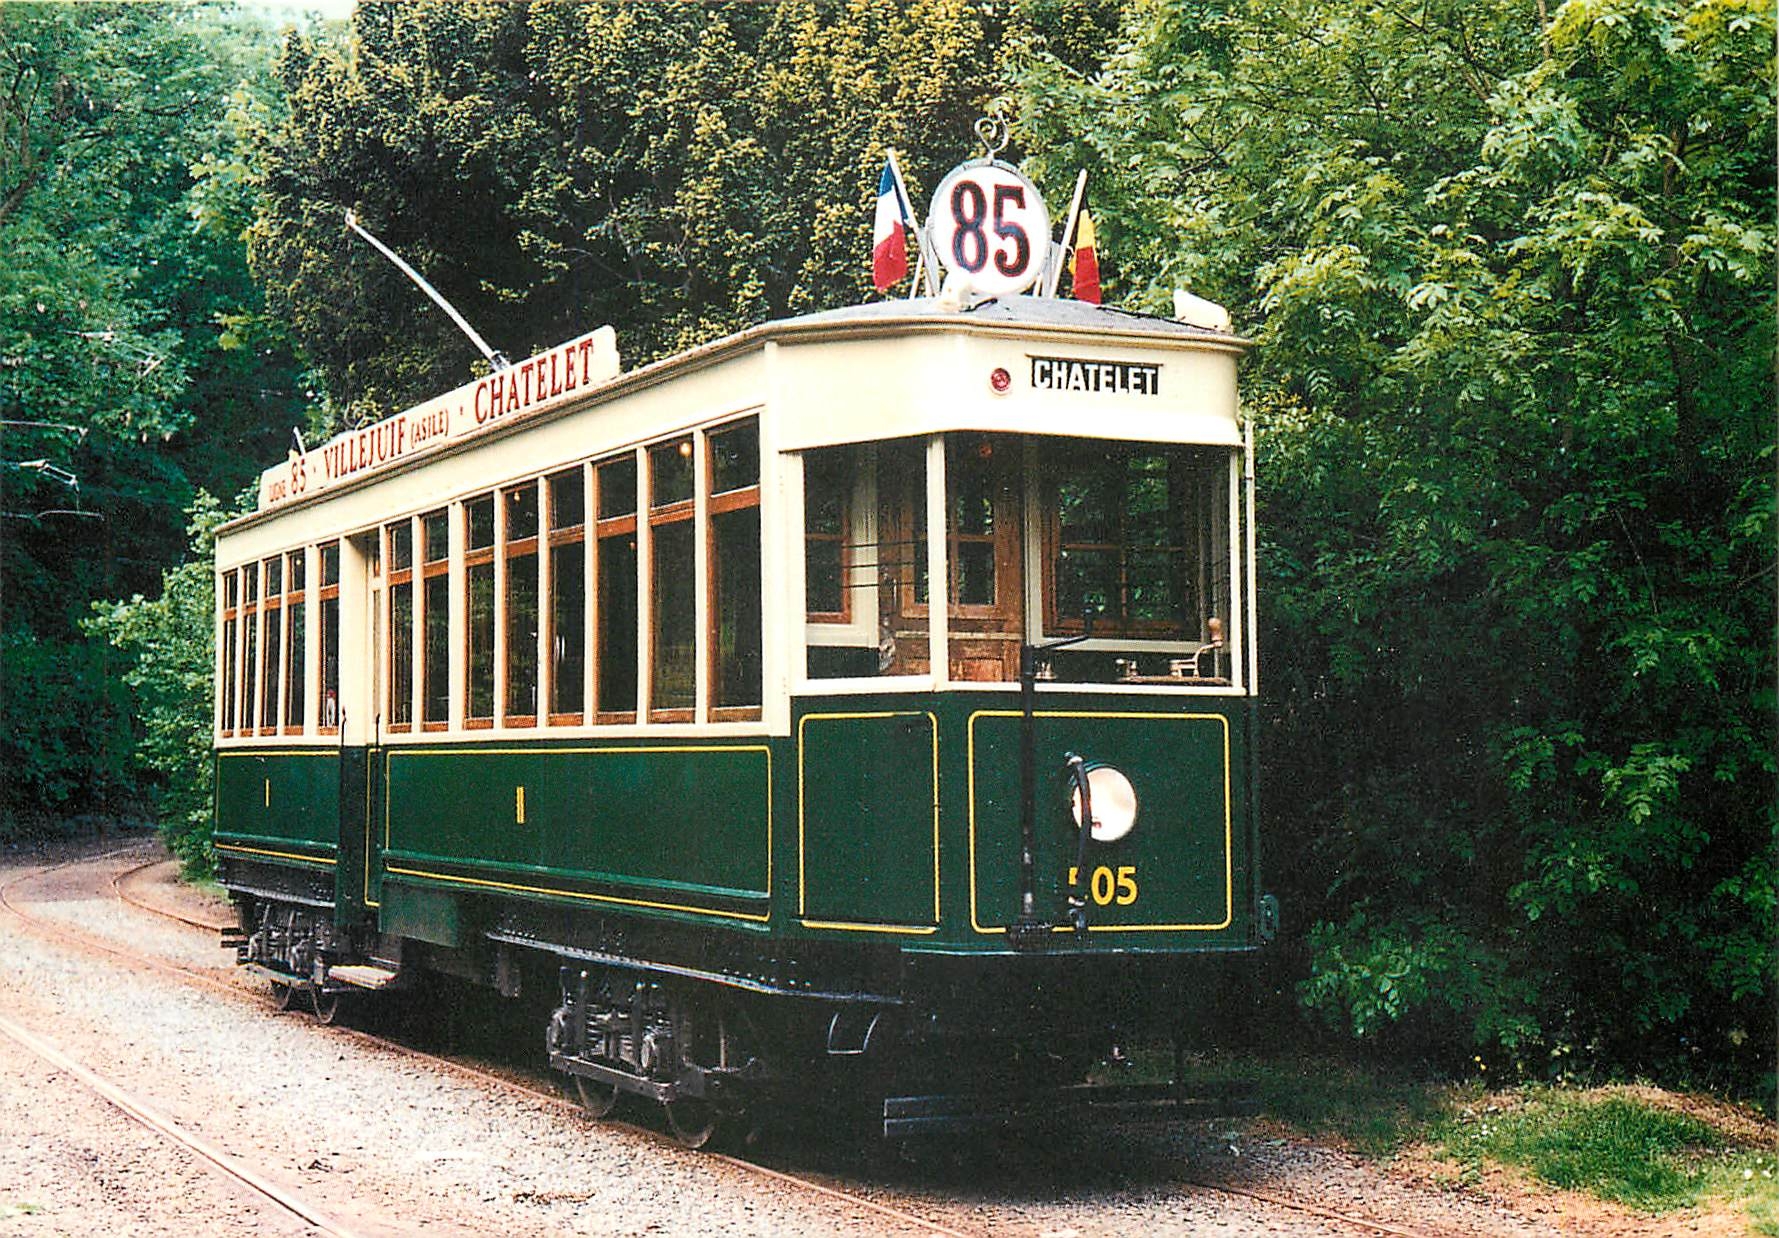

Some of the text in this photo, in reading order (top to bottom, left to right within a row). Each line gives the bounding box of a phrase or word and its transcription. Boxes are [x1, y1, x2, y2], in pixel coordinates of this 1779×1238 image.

[951, 180, 1031, 278] 85
[291, 458, 307, 495] 85
[323, 416, 407, 480] VILLEJUIF
[410, 408, 450, 450] (ASILE)
[474, 338, 595, 425] CHATELET
[1034, 359, 1157, 396] CHATELET
